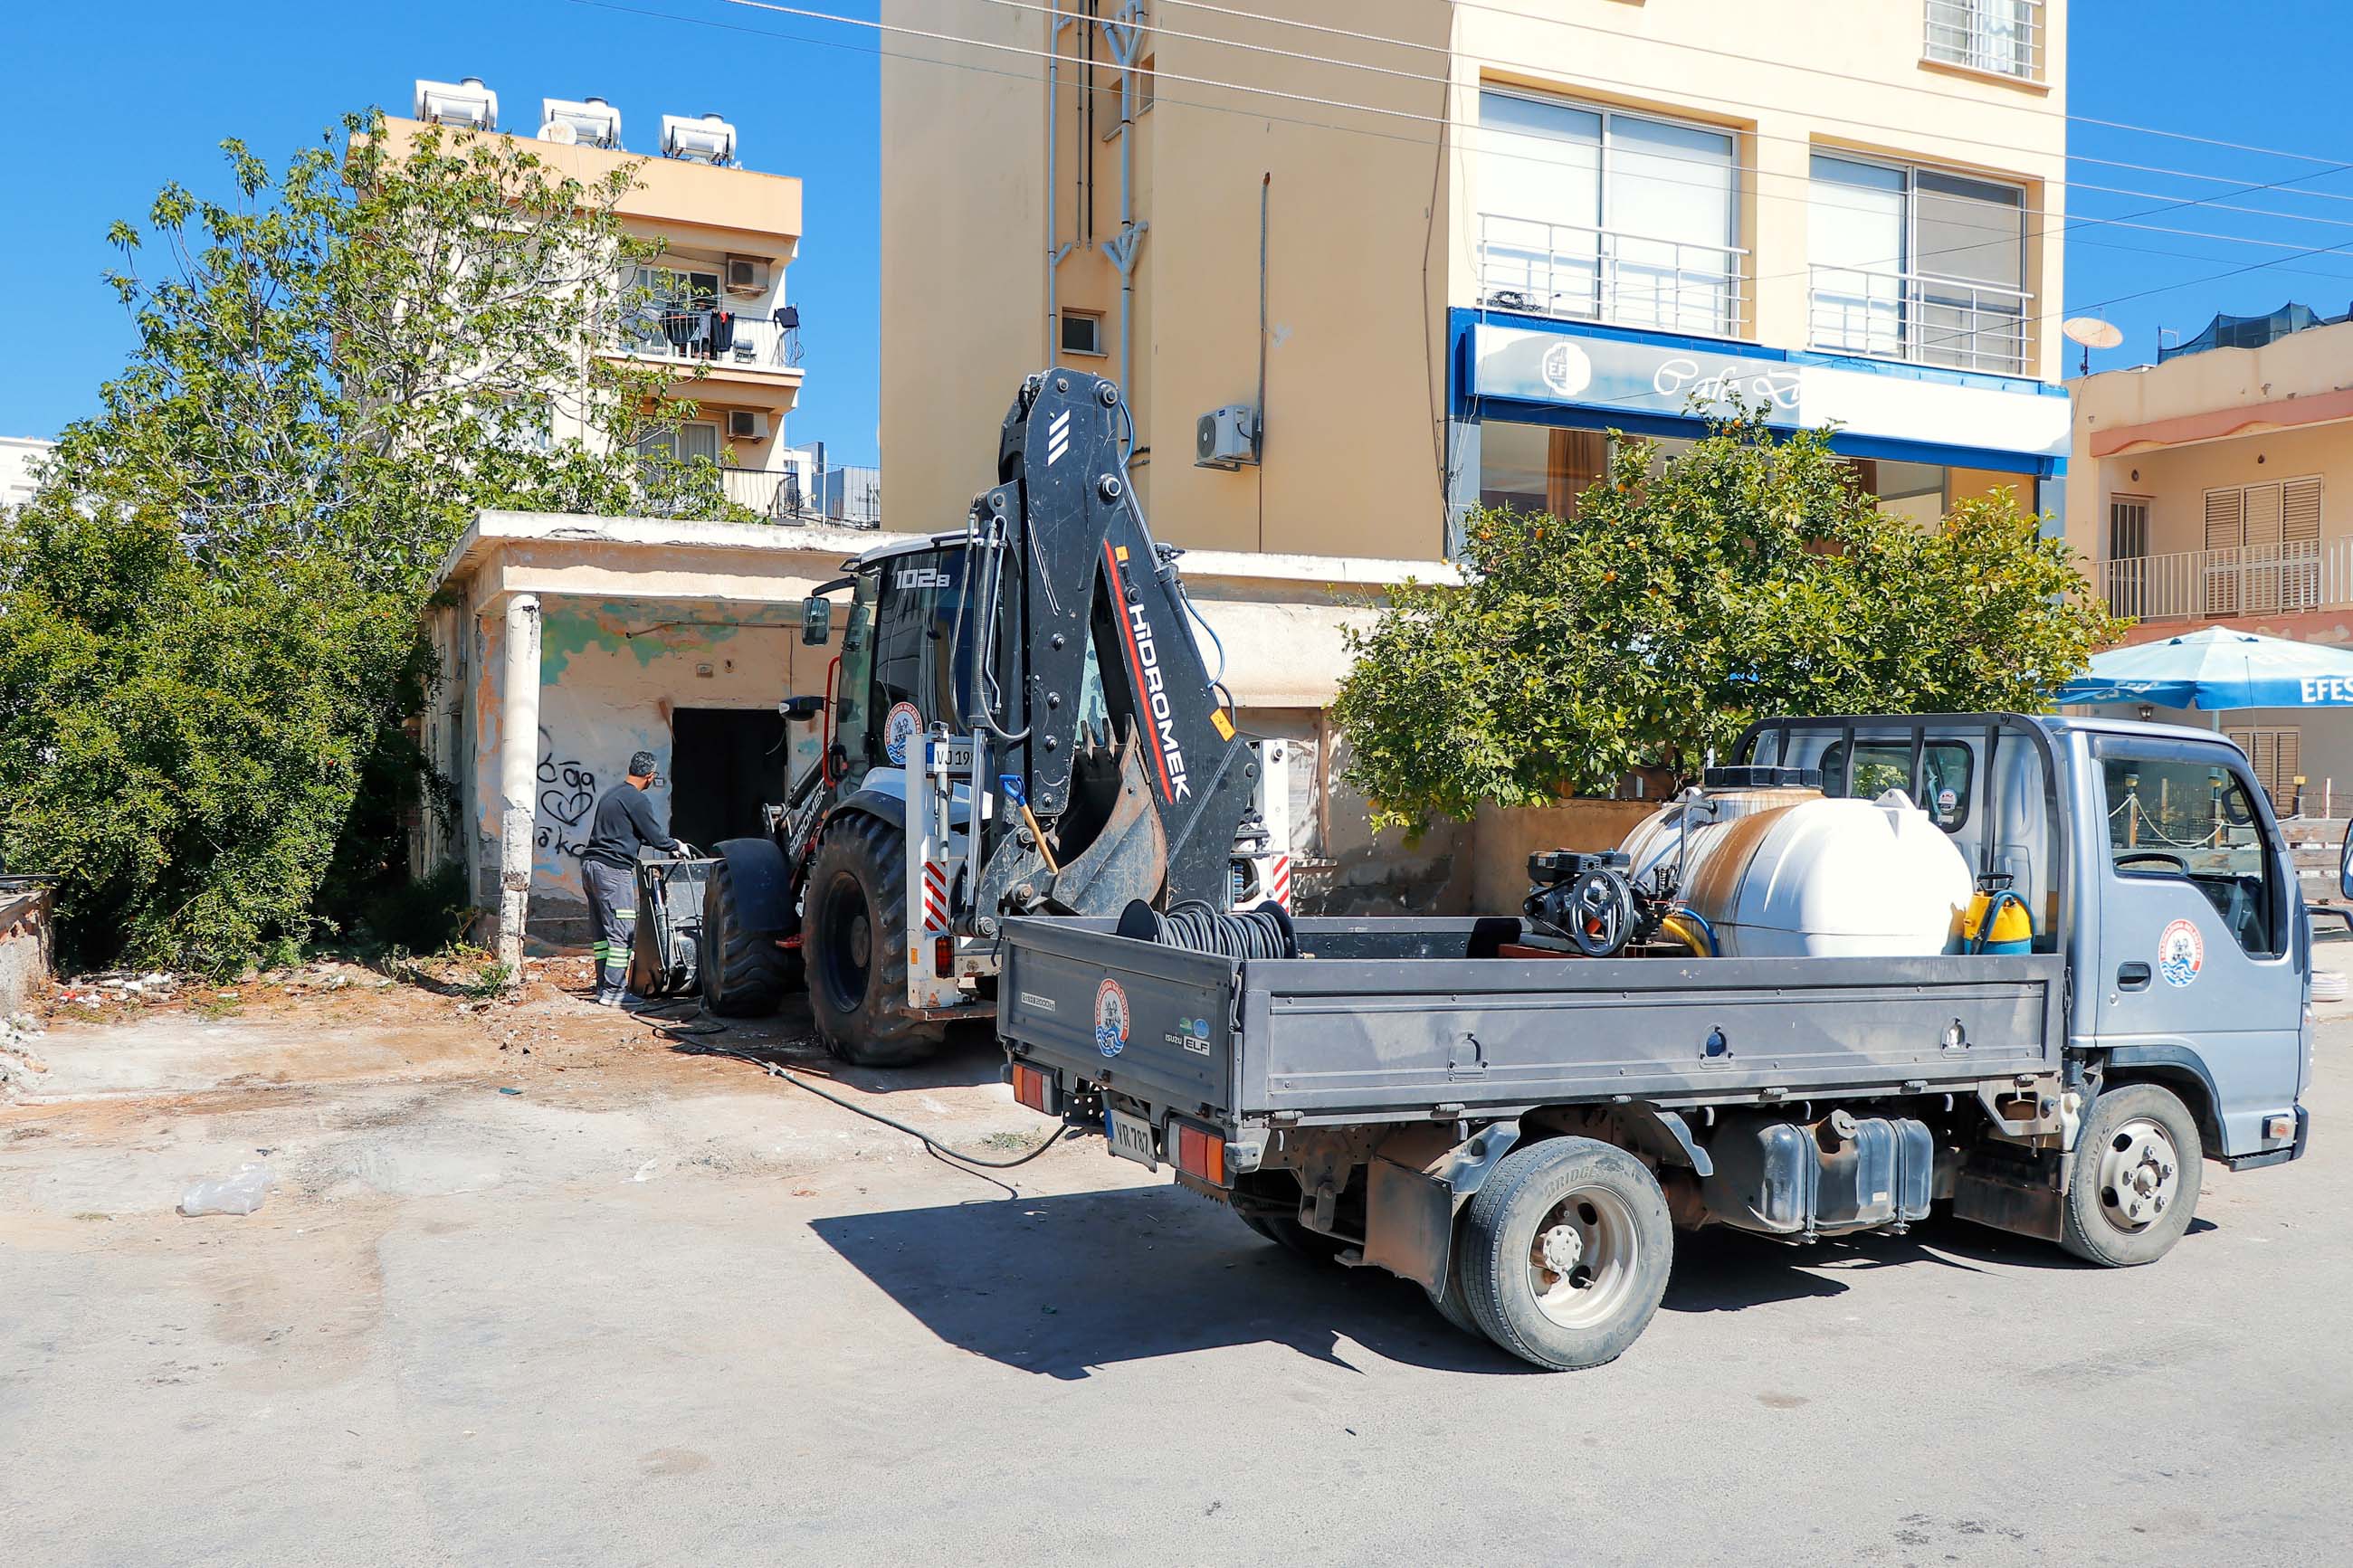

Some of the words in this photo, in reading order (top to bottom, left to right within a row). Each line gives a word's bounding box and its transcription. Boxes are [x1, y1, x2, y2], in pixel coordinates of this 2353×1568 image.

[896, 568, 950, 589] 102B
[937, 750, 952, 765] VJ
[956, 750, 974, 765] 19
[1165, 1033, 1183, 1045] ISUZU
[1186, 1039, 1208, 1051] ELF
[1115, 1121, 1131, 1148] YR
[1130, 1126, 1148, 1155] 787
